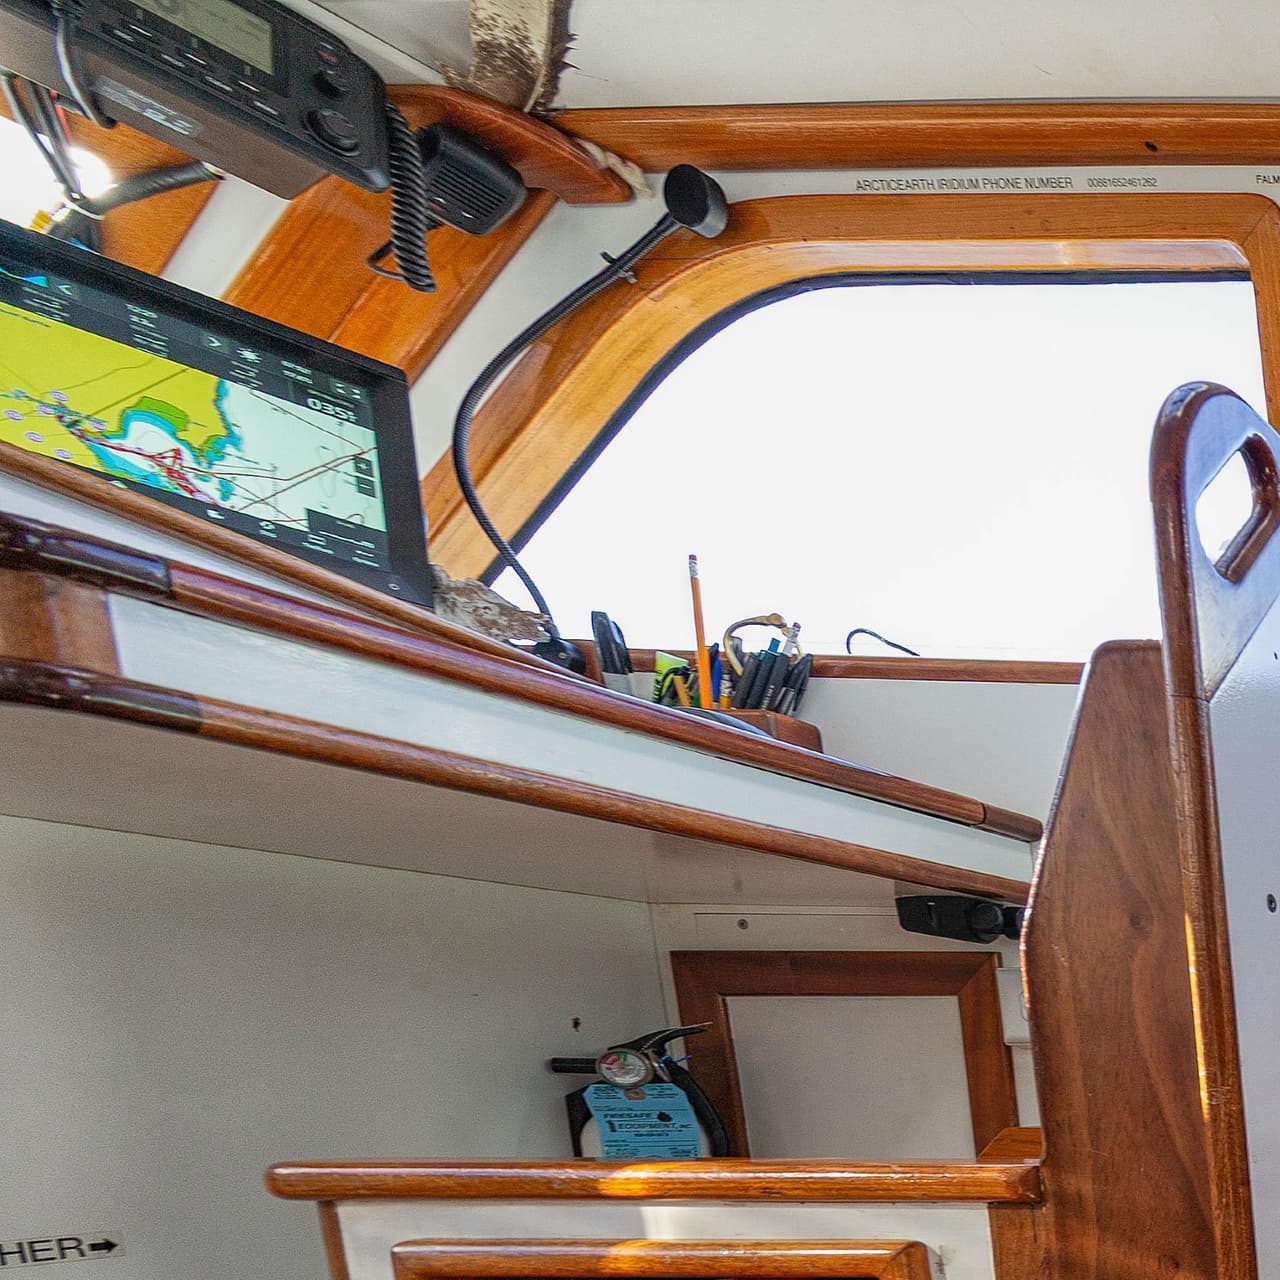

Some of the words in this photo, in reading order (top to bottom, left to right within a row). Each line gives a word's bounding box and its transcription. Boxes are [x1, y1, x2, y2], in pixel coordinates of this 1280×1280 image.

[856, 180, 934, 191] ARCTICEARTH
[937, 179, 980, 190] IRIDIUM
[984, 178, 1022, 189] PHONE
[1025, 177, 1073, 189] NUMBER
